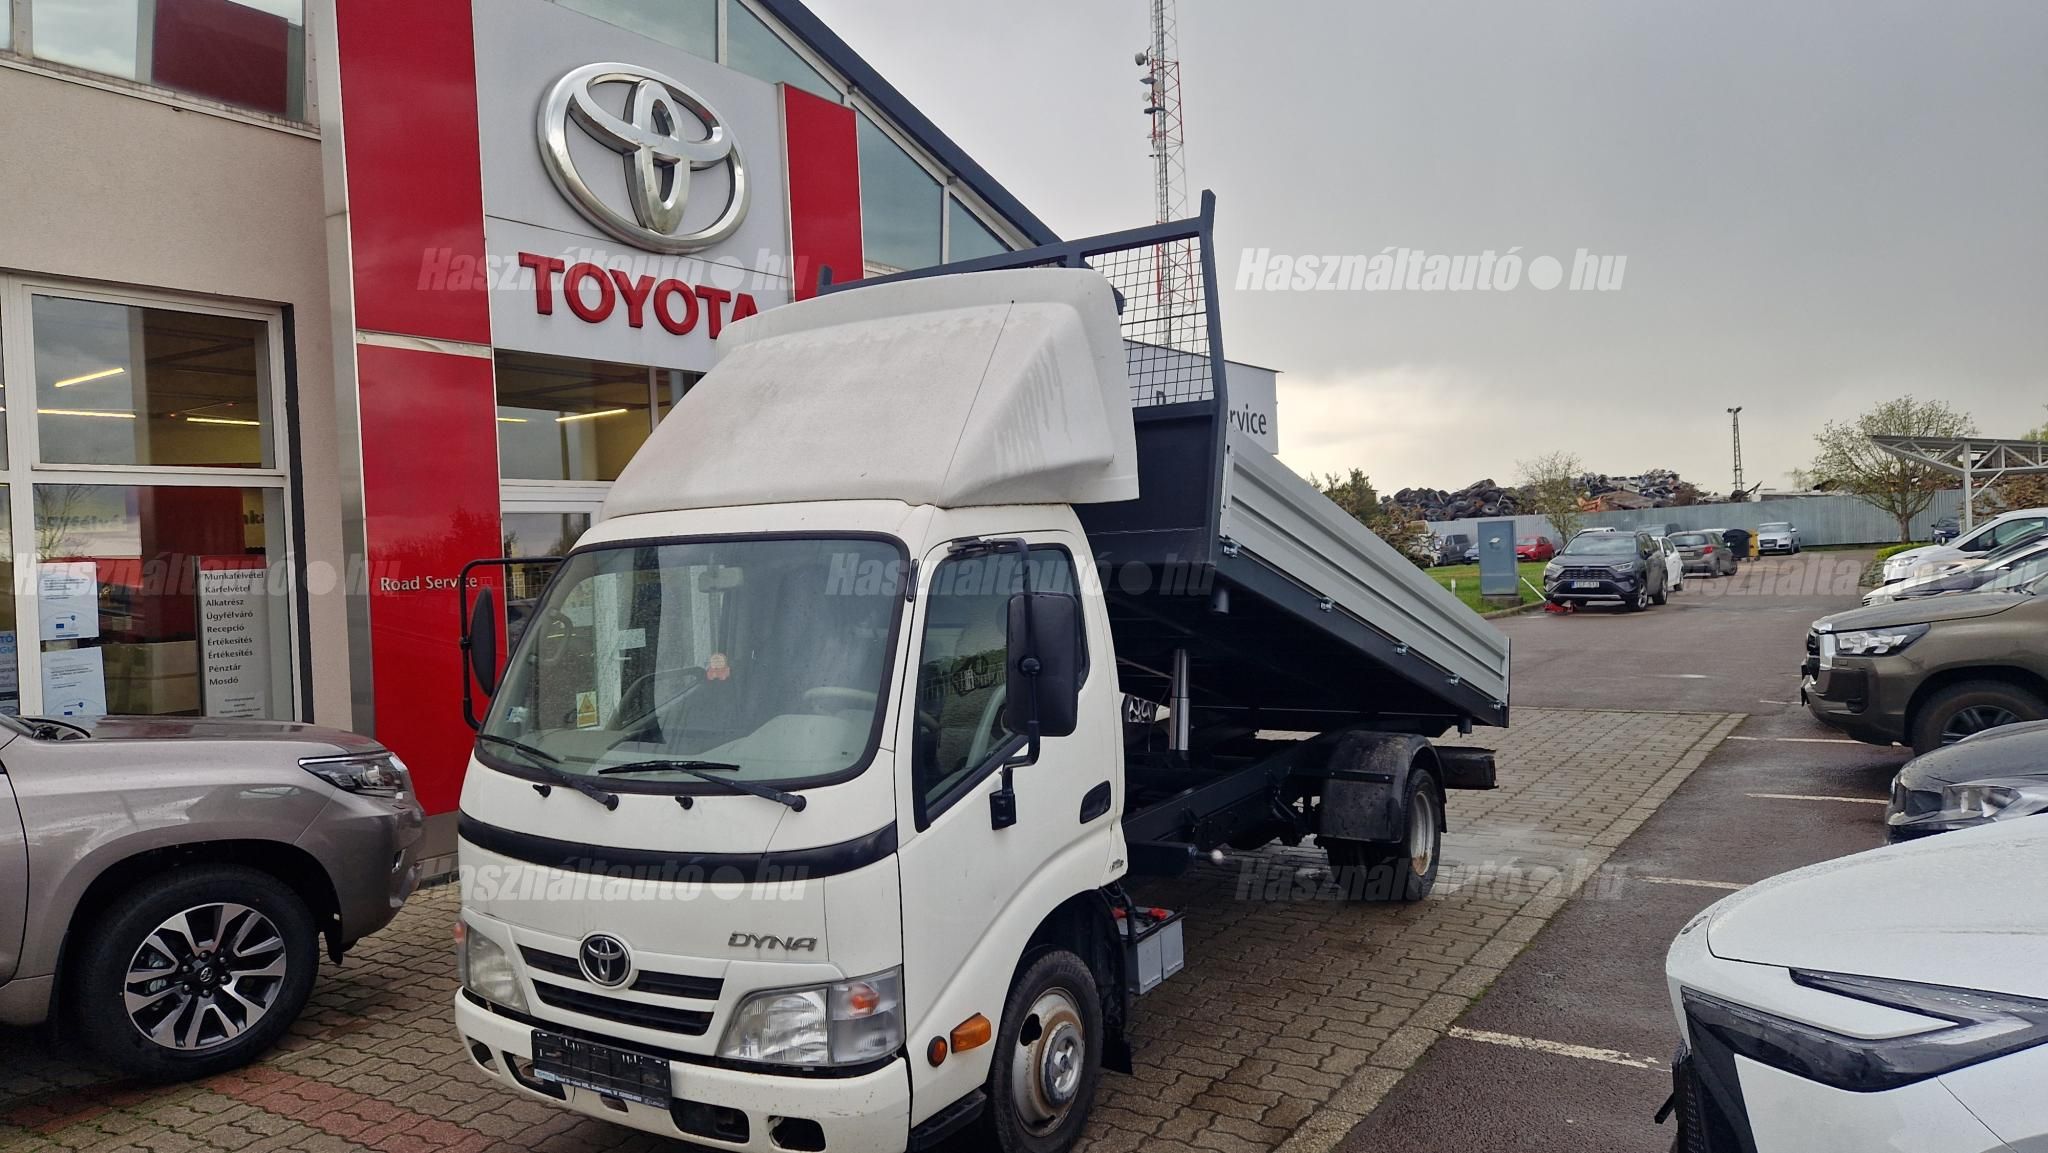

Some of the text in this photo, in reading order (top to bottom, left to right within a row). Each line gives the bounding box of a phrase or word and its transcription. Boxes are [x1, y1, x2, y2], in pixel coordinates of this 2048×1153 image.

[1226, 403, 1267, 435] rvice
[204, 571, 264, 580] Munkafelvétel
[380, 576, 420, 591] Road
[206, 611, 253, 621] Ügyfélváró
[207, 624, 244, 633] Recepció
[207, 637, 253, 646] Értékesítés
[208, 649, 253, 659] Értékesítés
[208, 664, 241, 673] Pénztár
[209, 676, 239, 685] Mosdó
[728, 932, 817, 952] DYNA
